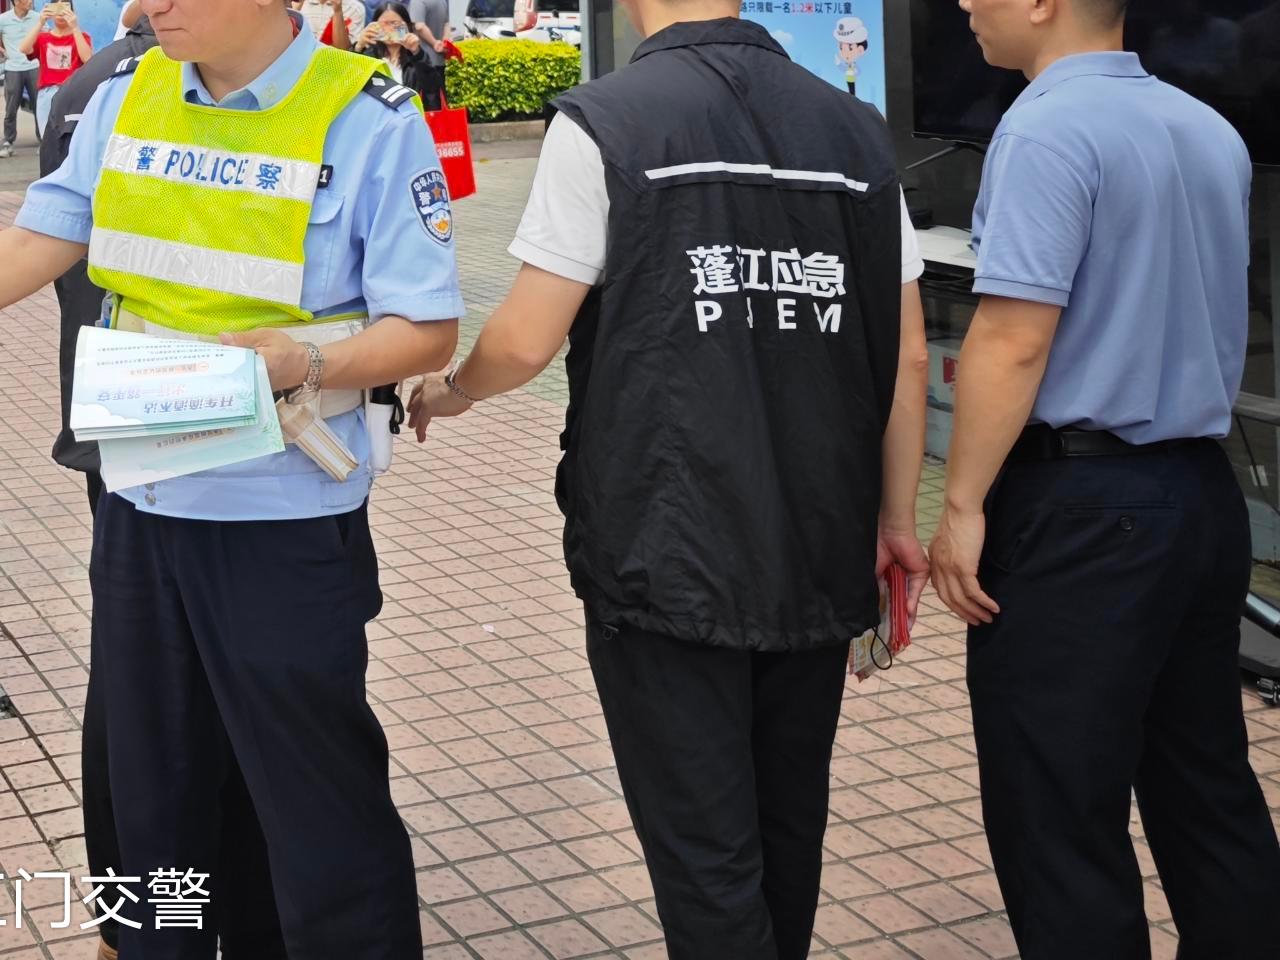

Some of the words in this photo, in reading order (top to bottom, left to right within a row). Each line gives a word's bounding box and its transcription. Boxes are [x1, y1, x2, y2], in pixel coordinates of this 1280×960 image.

[136, 145, 157, 171] 警
[164, 149, 249, 185] POLICE
[256, 163, 282, 190] 察
[686, 244, 847, 299] 蓬江应急
